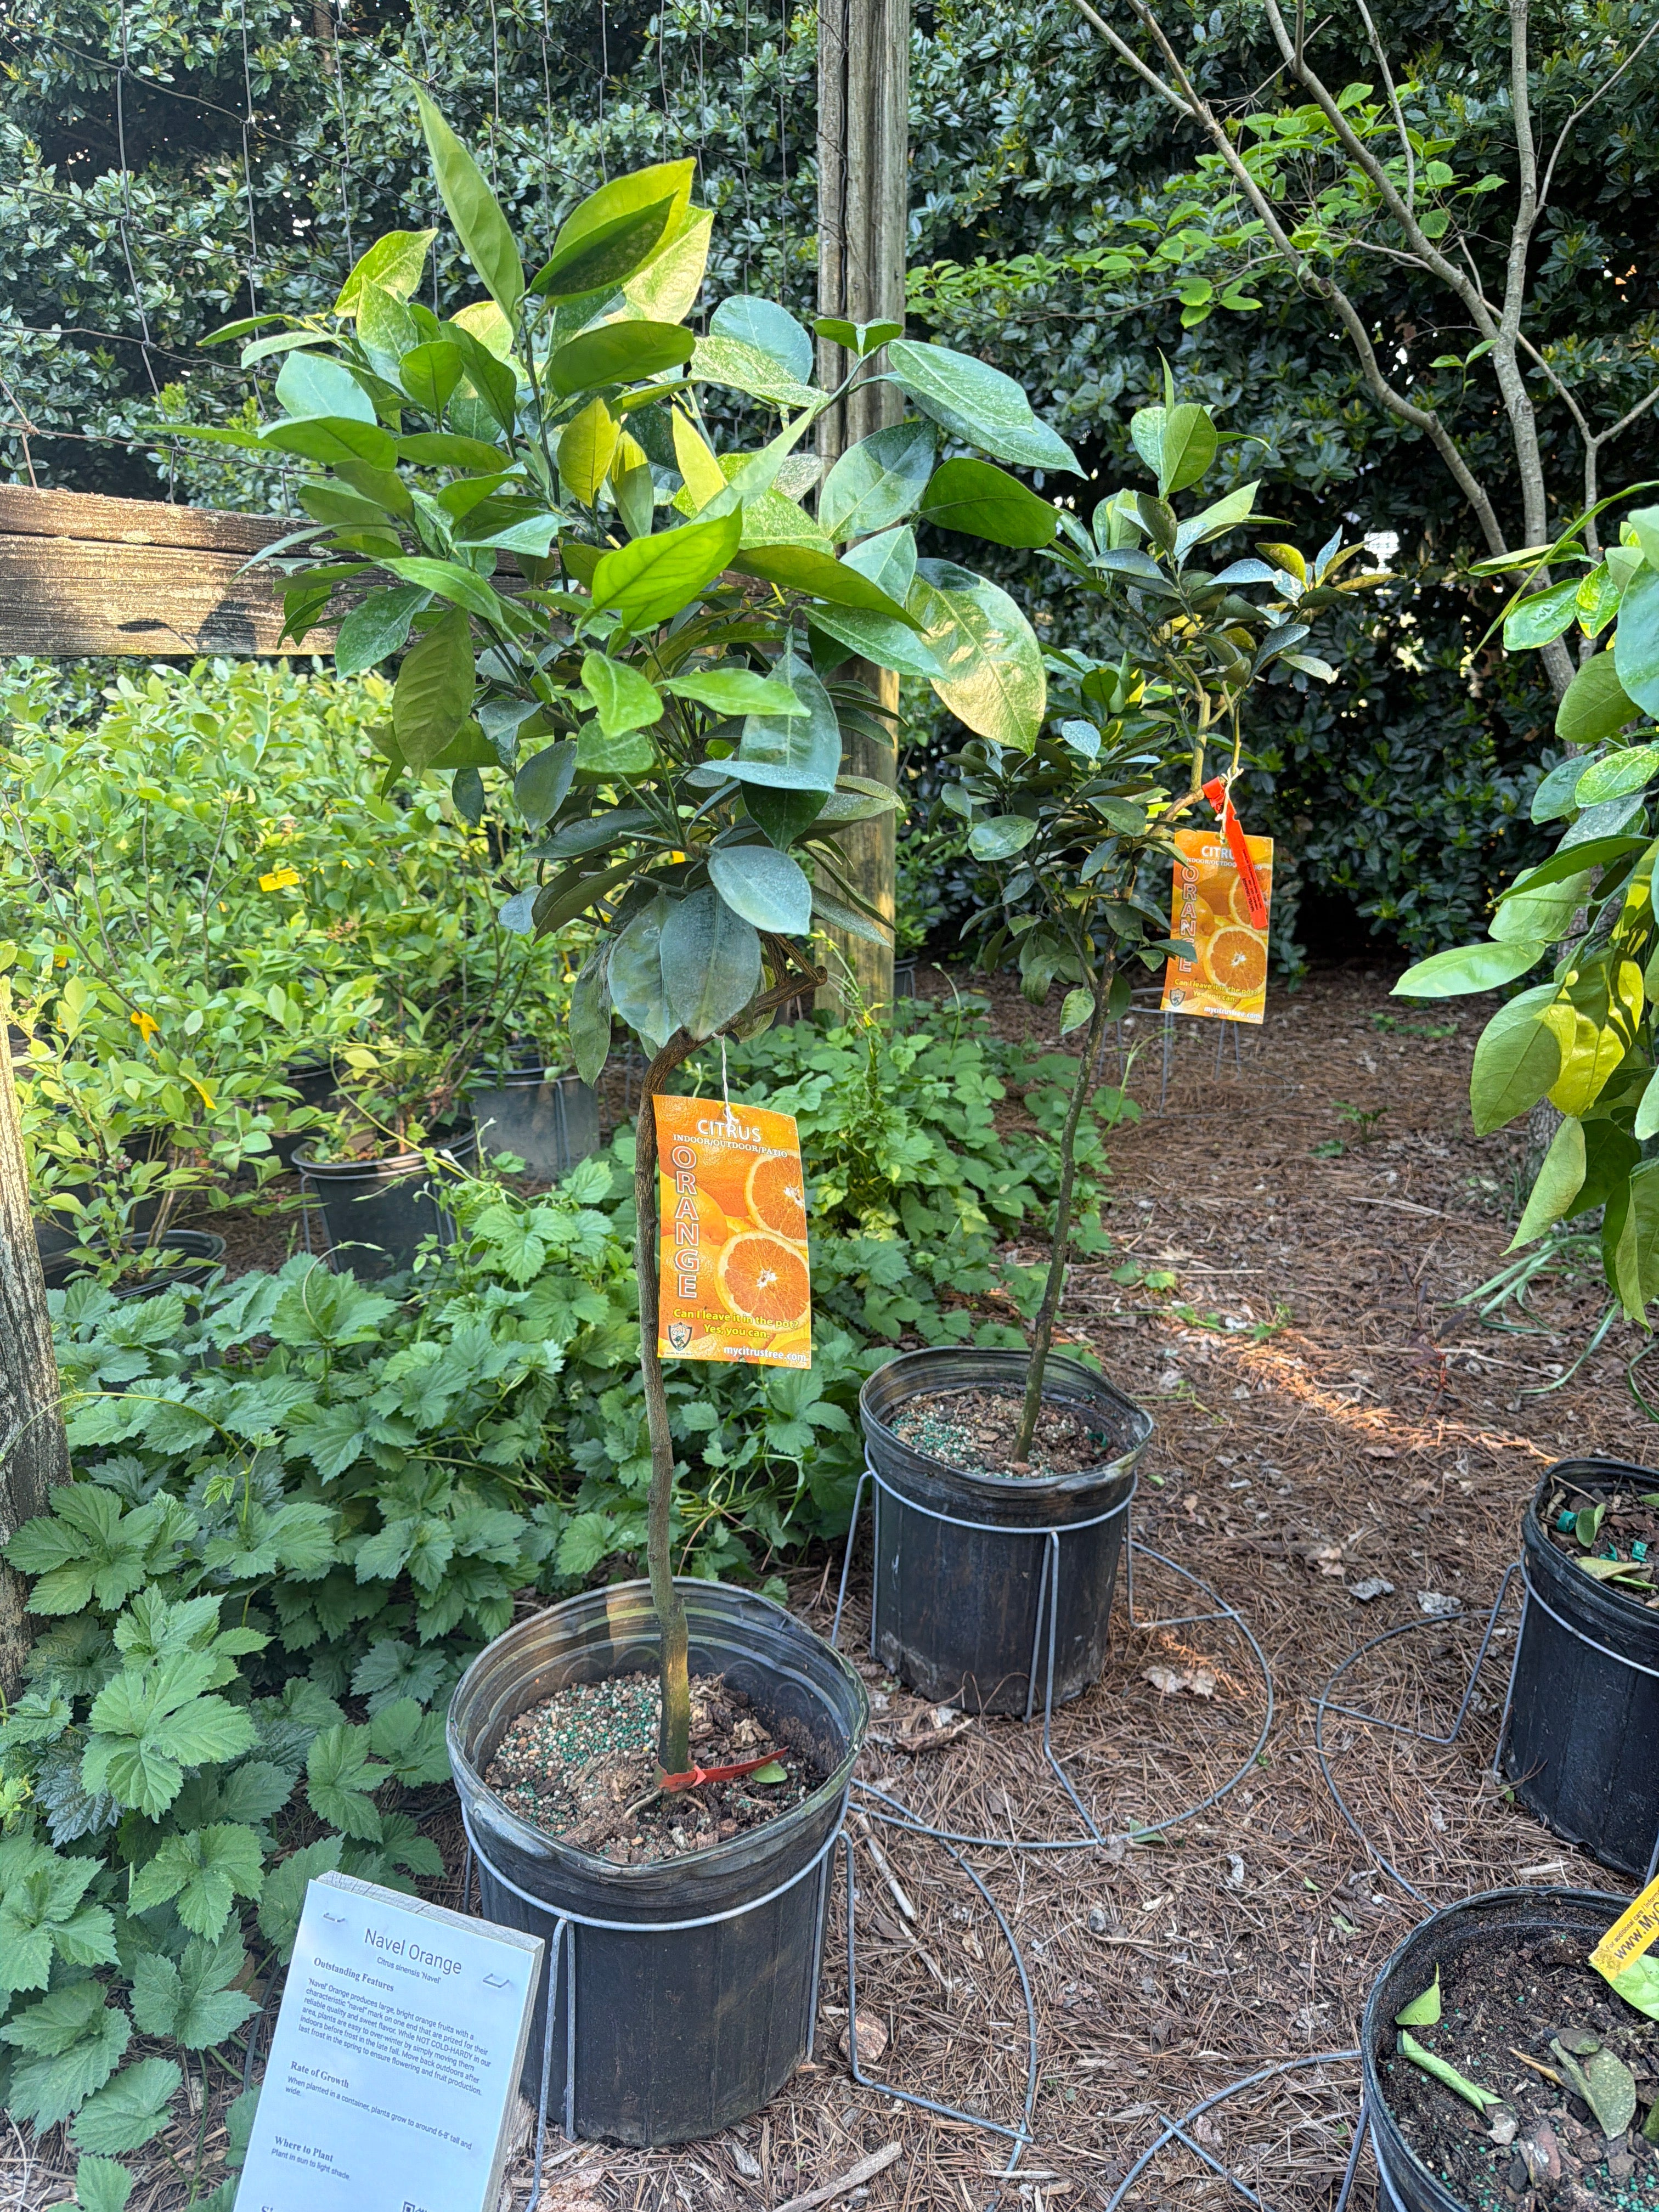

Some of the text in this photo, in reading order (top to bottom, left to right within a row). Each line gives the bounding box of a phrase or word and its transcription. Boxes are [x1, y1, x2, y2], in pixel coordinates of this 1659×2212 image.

[1192, 980, 1212, 990] leave
[1204, 1006, 1261, 1020] mycitrustree.com
[673, 1134, 788, 1158] INDOOR/OUTDOOR/PATIO
[697, 1120, 762, 1142] CITRUS
[672, 1146, 699, 1298] ORANGE
[673, 1308, 799, 1330] Can I leave it in the pot?
[704, 1324, 770, 1339] Yes, you can.
[724, 1346, 807, 1362] mycitrustree.com
[1605, 1942, 1616, 1952] For
[1614, 1919, 1634, 1943] additional
[1633, 1910, 1644, 1921] care
[364, 1928, 461, 1975] Navel Orange
[377, 1957, 394, 1968] Citrus
[395, 1963, 420, 1977] sinensis
[314, 1957, 393, 1991] Outstanding Features
[306, 1988, 346, 2007] characteristic
[367, 2010, 382, 2019] mark
[406, 2023, 417, 2031] end
[419, 2025, 431, 2035] that
[442, 2035, 462, 2046] prized
[464, 2040, 472, 2050] for
[474, 2045, 488, 2055] their
[328, 1985, 349, 1997] Orange
[349, 1993, 377, 2007] produces
[379, 2001, 394, 2014] large,
[396, 2007, 414, 2021] bright
[415, 2016, 436, 2027] orange
[436, 2022, 454, 2033] fruits
[456, 2029, 468, 2038] with
[302, 2007, 316, 2017] area,
[317, 2012, 336, 2023] plants
[348, 2022, 362, 2033] easy
[370, 2030, 403, 2047] over-winter
[404, 2040, 411, 2051] by
[413, 2045, 433, 2057] simply
[434, 2052, 456, 2066] moving
[459, 2060, 474, 2071] them
[304, 1997, 325, 2009] reliable
[326, 2005, 346, 2018] quality
[347, 2013, 358, 2021] and
[359, 2017, 377, 2028] sweet
[379, 2022, 396, 2034] flavor.
[398, 2028, 414, 2040] While
[415, 2034, 430, 2045] NOT
[431, 2040, 472, 2059] COLD-HARDY
[298, 2024, 309, 2033] last
[311, 2028, 325, 2039] frost
[333, 2036, 342, 2045] the
[343, 2041, 361, 2053] spring
[370, 2051, 390, 2062] ensure
[392, 2057, 420, 2073] flowering
[421, 2068, 433, 2076] and
[434, 2071, 447, 2081] fruit
[448, 2078, 481, 2095] production.
[300, 2015, 479, 2083] indoors before frost in the late fall. Move back outdoors after
[290, 2061, 308, 2074] Rate
[320, 2071, 348, 2087] Growth
[286, 2086, 301, 2096] wide.
[288, 2075, 305, 2087] When
[306, 2082, 329, 2095] planted
[341, 2095, 369, 2111] container,
[371, 2106, 390, 2117] plants
[391, 2114, 407, 2123] grow
[415, 2123, 437, 2134] around
[450, 2135, 460, 2144] tall
[460, 2141, 471, 2149] and
[271, 2148, 288, 2159] Plant
[317, 2162, 330, 2172] light
[331, 2169, 349, 2180] shade.
[275, 2136, 332, 2162] Where to Plant
